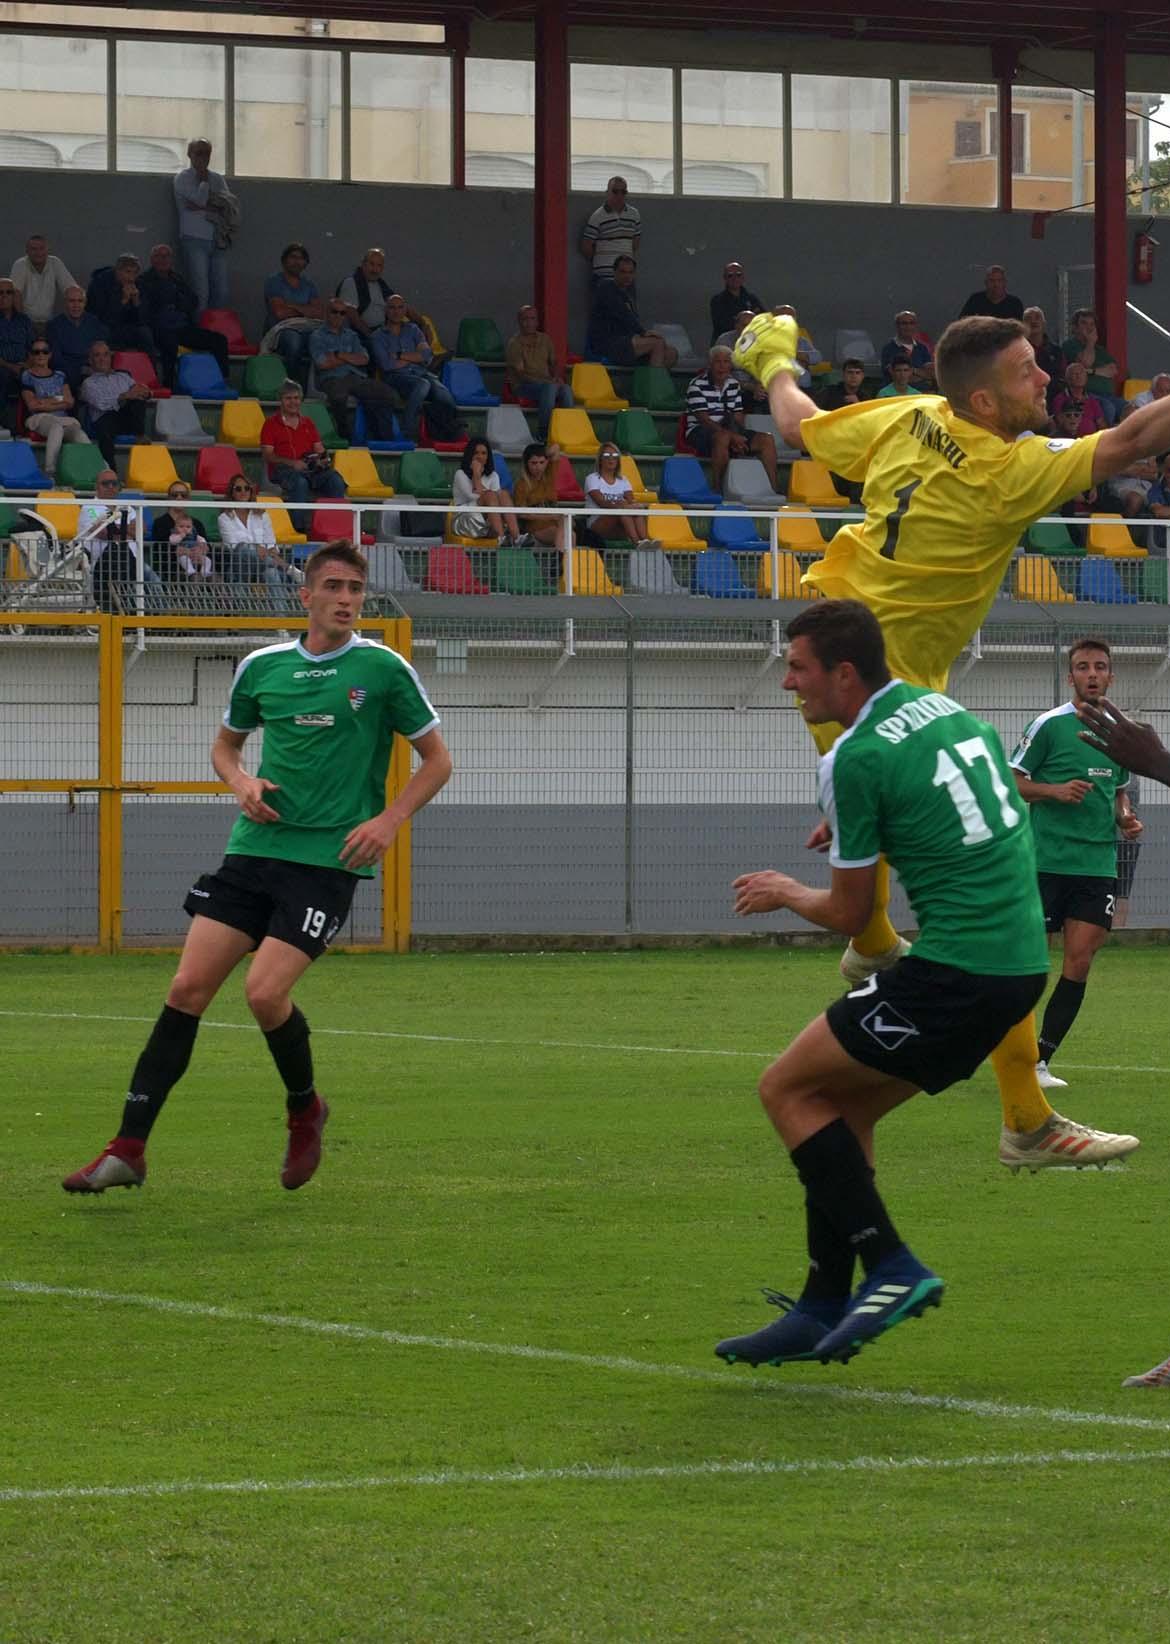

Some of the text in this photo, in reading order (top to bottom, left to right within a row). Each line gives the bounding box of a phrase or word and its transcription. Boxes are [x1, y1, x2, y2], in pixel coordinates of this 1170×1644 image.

[879, 477, 923, 561] 1
[292, 668, 338, 679] GIVOVA
[932, 736, 1019, 845] 17
[302, 907, 327, 939] 19
